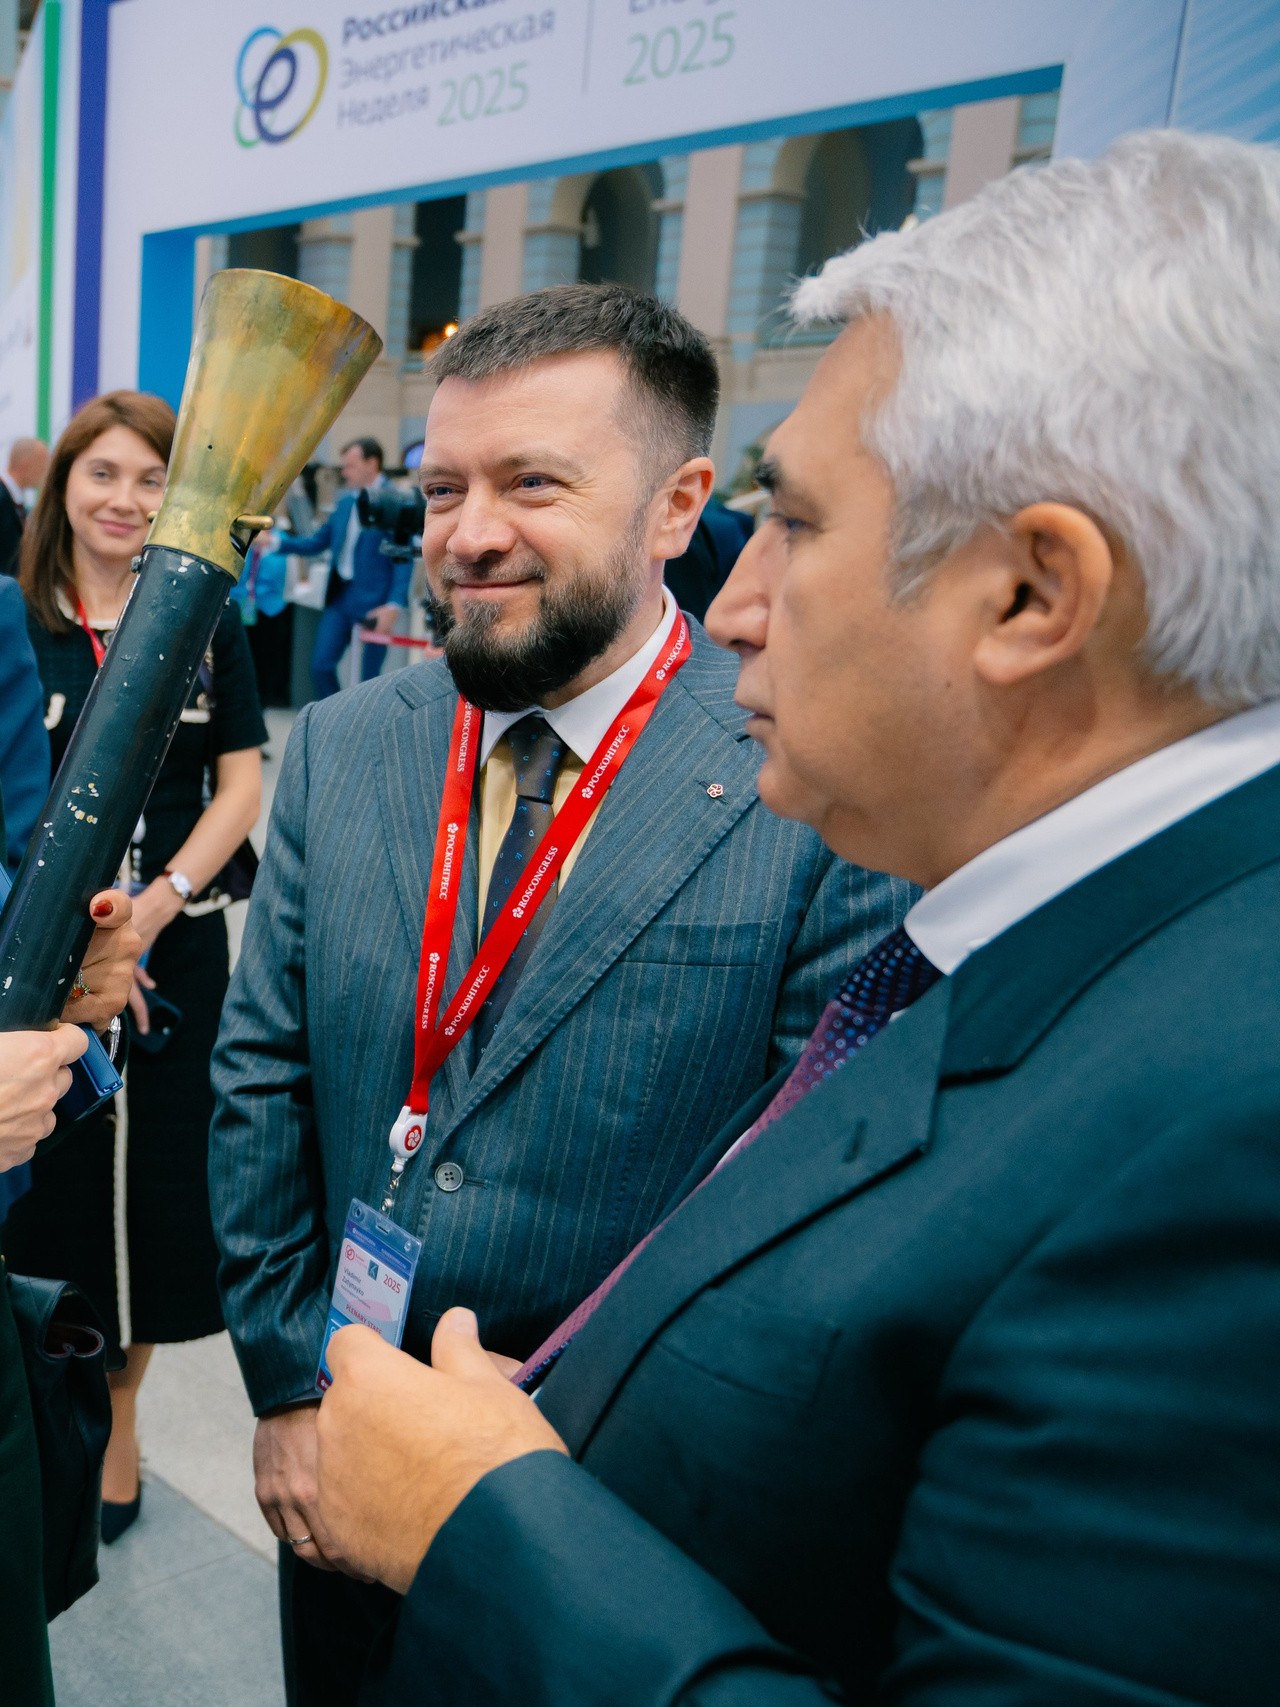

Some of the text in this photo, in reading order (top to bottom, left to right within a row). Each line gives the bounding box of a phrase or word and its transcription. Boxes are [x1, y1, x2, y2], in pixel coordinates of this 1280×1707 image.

[339, 8, 556, 89] Энергетическая
[622, 9, 738, 86] 2025
[336, 59, 529, 129] Неделя 2025
[457, 710, 472, 773] ROSCONGRESS
[587, 724, 630, 789] РОСКОНГРЕСС
[439, 833, 456, 900] РОСКОНГРЕСС
[518, 845, 559, 909] ROSCONGRESS
[421, 963, 438, 1030] ROSCONGRESS
[450, 964, 490, 1027] РОСКОНГРЕСС
[345, 1303, 367, 1324] PLENARY
[383, 1273, 401, 1295] 2025
